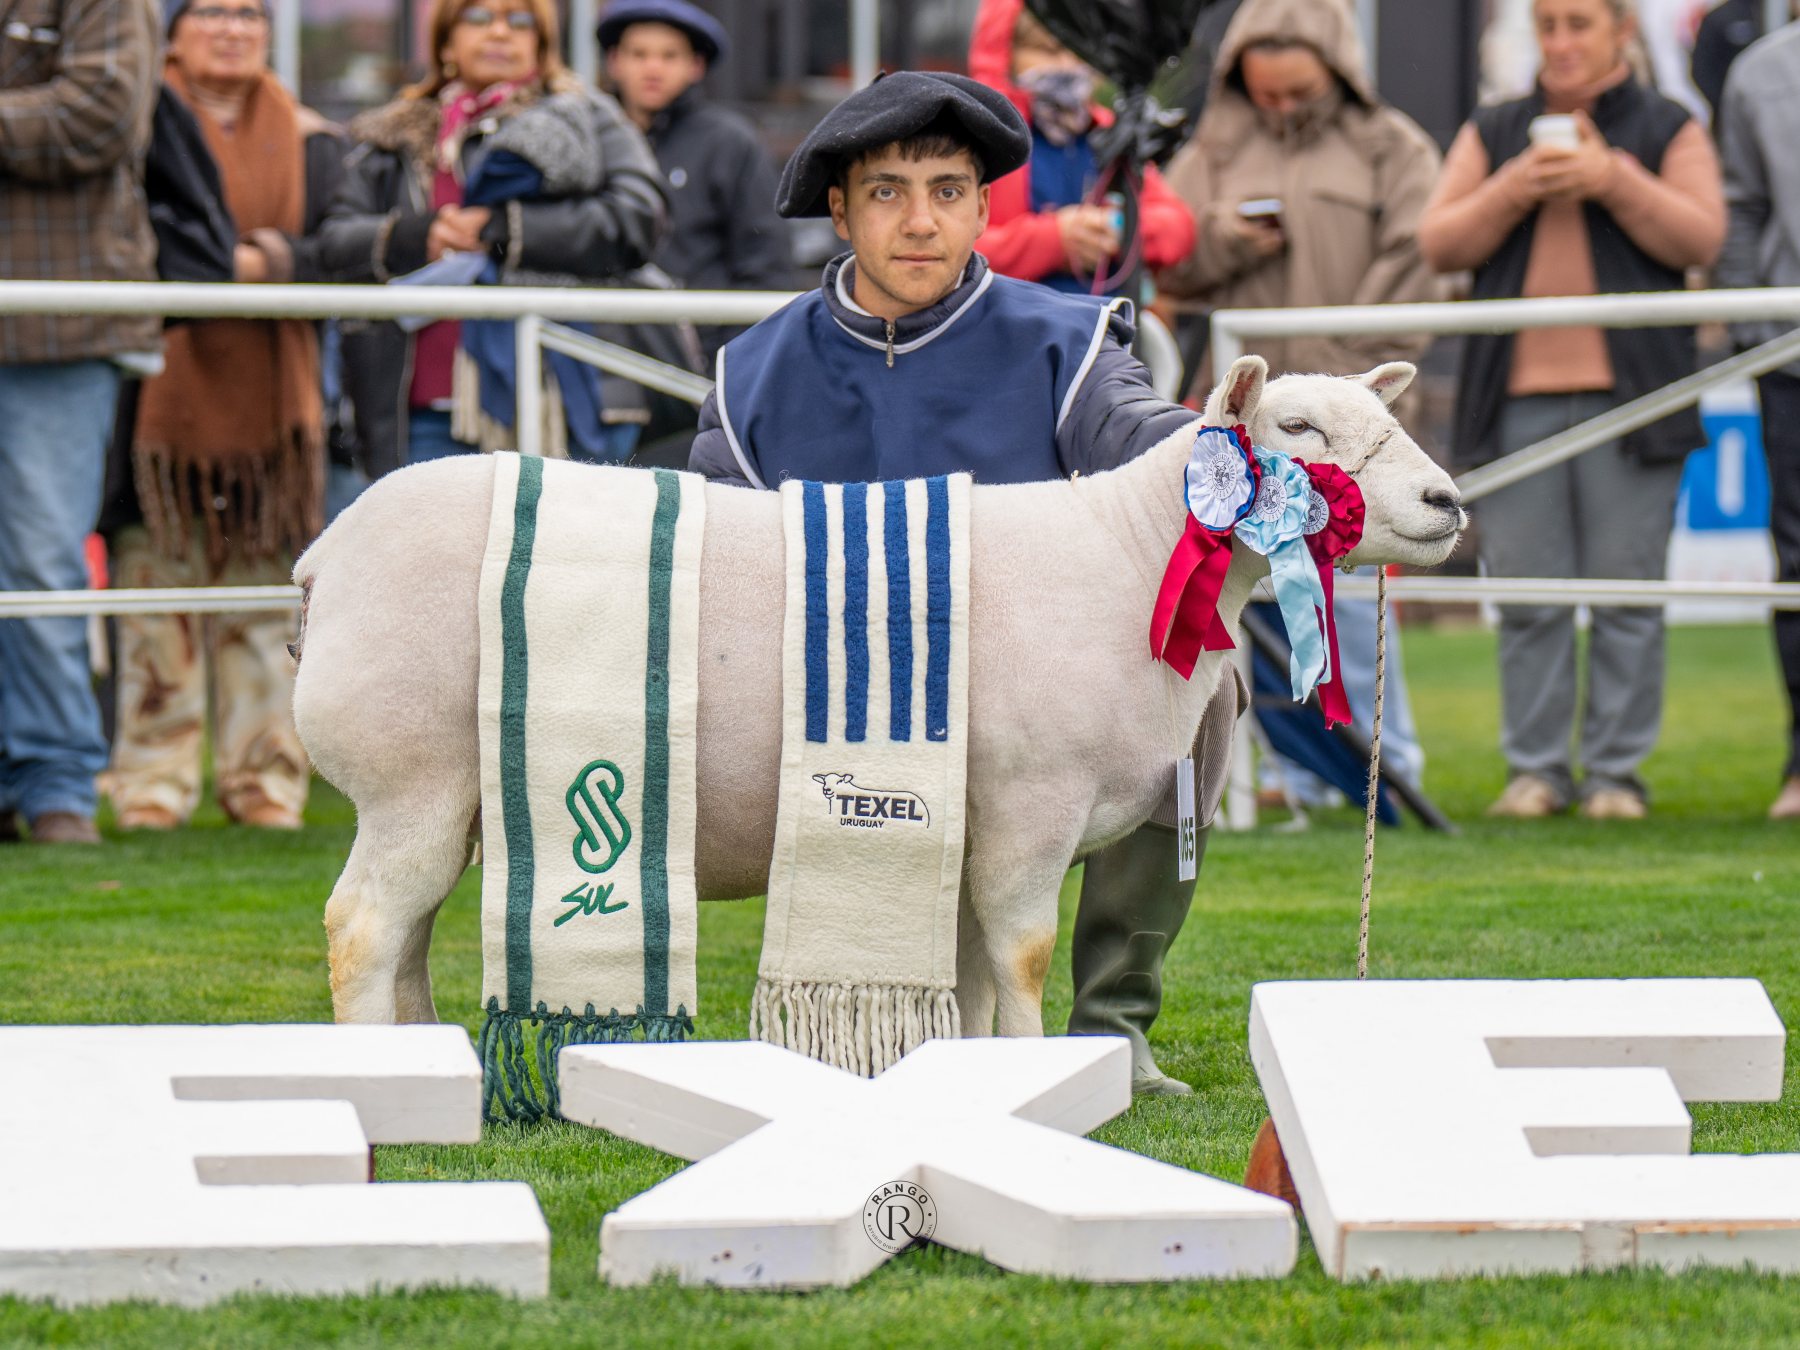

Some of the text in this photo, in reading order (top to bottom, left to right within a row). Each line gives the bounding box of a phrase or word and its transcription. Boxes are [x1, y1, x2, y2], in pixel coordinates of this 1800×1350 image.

[836, 794, 923, 821] TEXEL
[840, 818, 884, 828] URUGUAY
[553, 881, 629, 928] SUL
